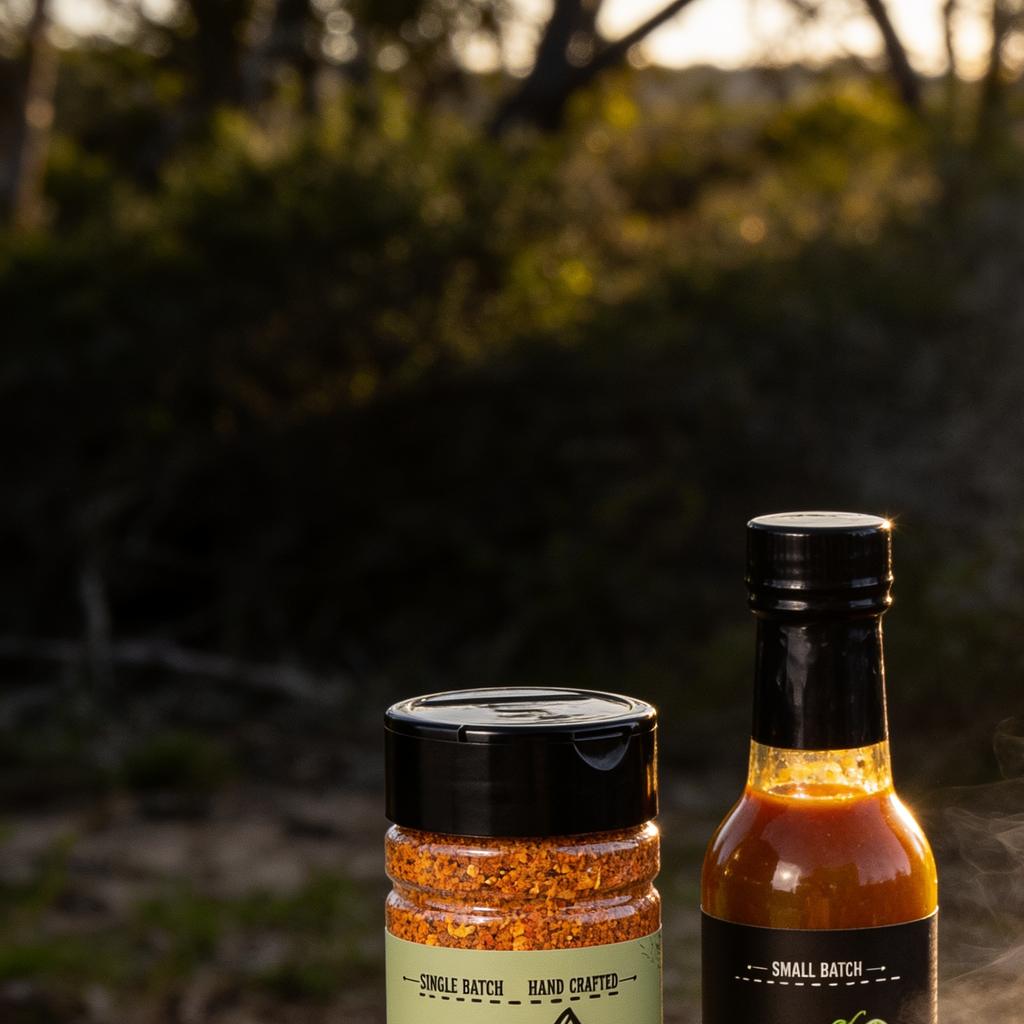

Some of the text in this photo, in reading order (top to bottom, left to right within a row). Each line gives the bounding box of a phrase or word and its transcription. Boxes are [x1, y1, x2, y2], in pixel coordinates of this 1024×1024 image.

[772, 961, 863, 978] SMALL BATCH
[419, 973, 619, 996] SINGLE BATCH HAND CRAFTED
